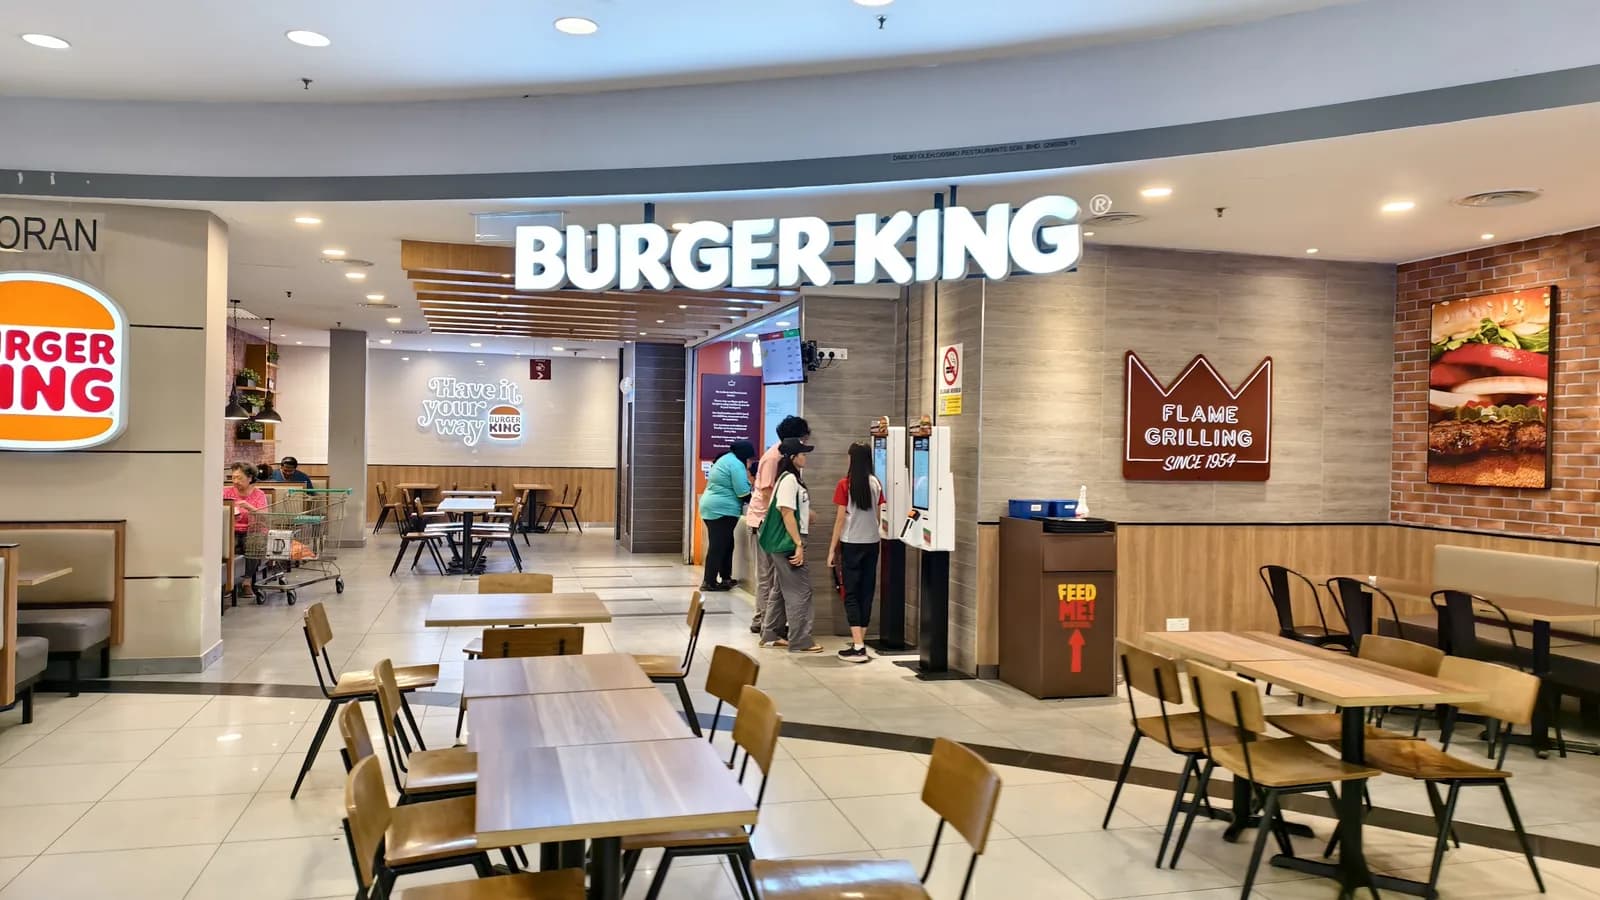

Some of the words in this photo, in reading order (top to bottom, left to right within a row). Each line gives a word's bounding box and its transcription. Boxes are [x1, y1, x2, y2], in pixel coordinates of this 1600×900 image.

[0, 215, 98, 252] ORAN
[514, 215, 836, 293] BURGER
[853, 194, 1082, 286] KING
[0, 329, 115, 366] RGER
[428, 375, 497, 400] Have
[499, 378, 523, 405] it
[417, 399, 488, 427] your
[489, 416, 521, 424] BURGER
[1162, 403, 1239, 424] FLAME
[435, 418, 487, 447] way
[489, 423, 521, 433] KING
[1144, 427, 1253, 448] GRILLING
[1162, 454, 1205, 471] SINCE
[1205, 452, 1237, 469] 1954
[1057, 583, 1097, 602] FEED
[1058, 600, 1096, 621] ME!
